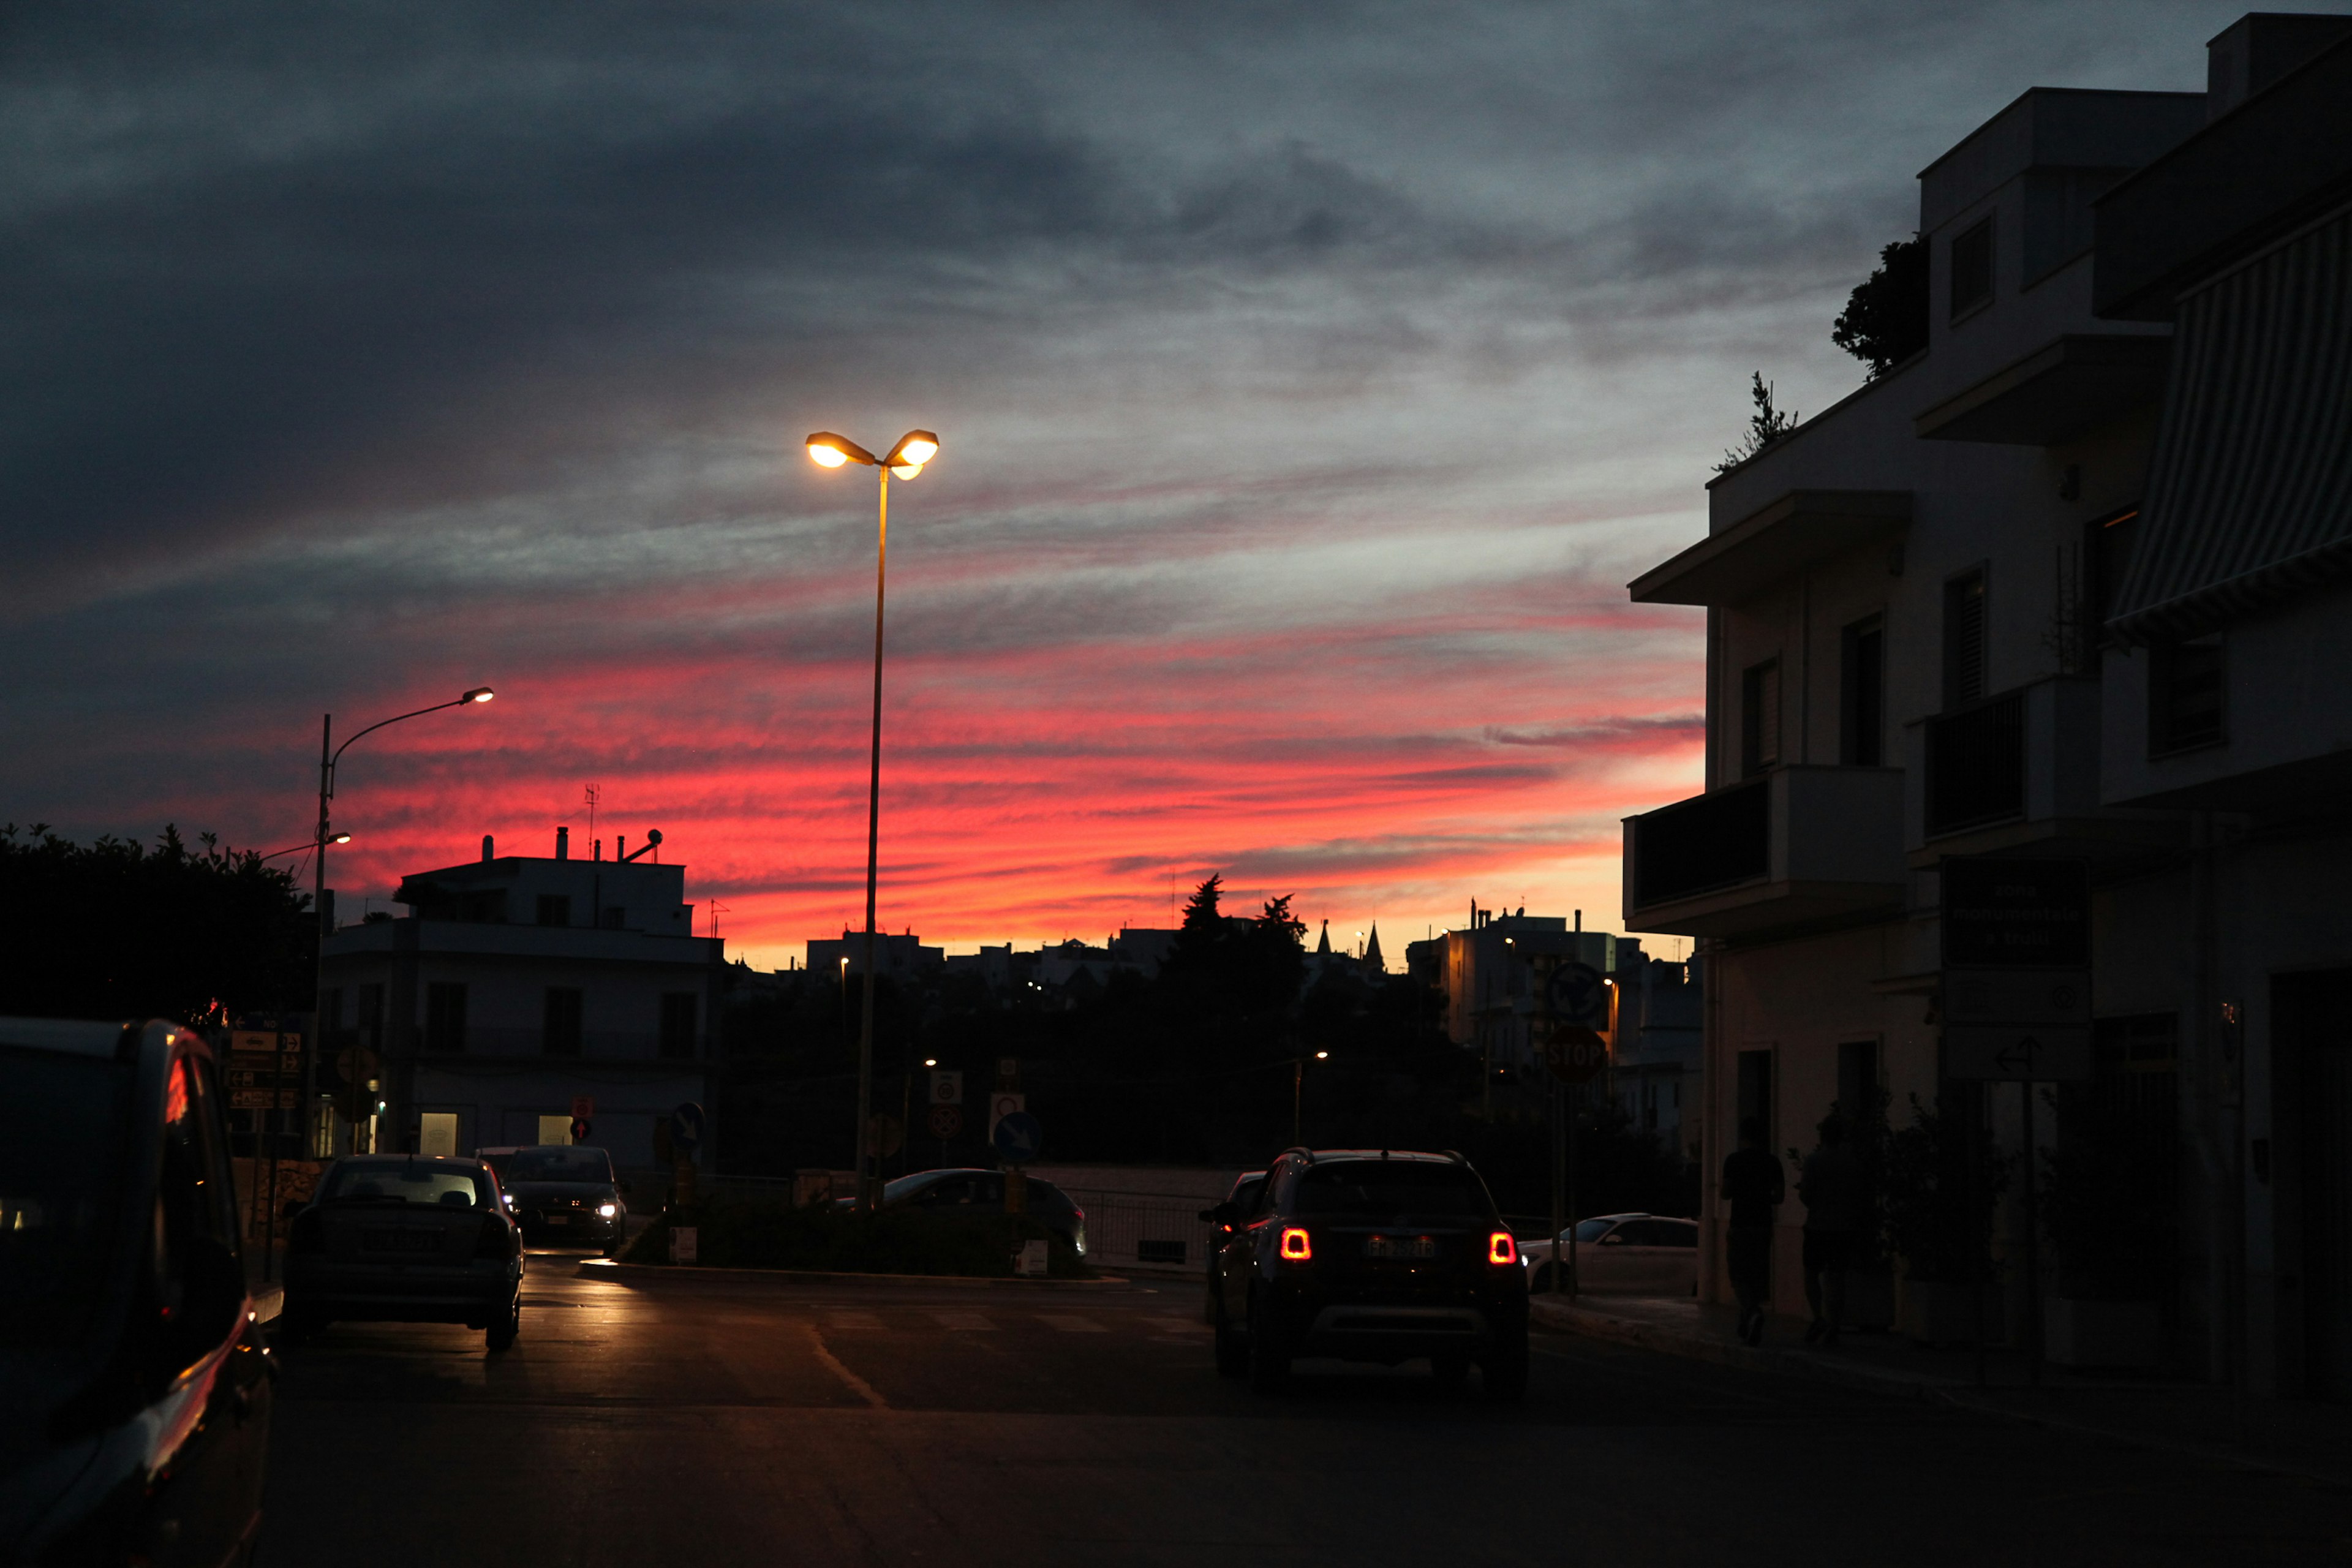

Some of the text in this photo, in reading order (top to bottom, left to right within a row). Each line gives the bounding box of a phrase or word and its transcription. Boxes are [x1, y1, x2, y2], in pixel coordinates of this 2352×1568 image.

[1995, 884, 2037, 897] zona
[1952, 907, 2079, 921] monumentale
[2004, 932, 2049, 945] trulli
[1549, 1043, 1601, 1066] STOP
[1371, 1242, 1432, 1256] FM 252TR
